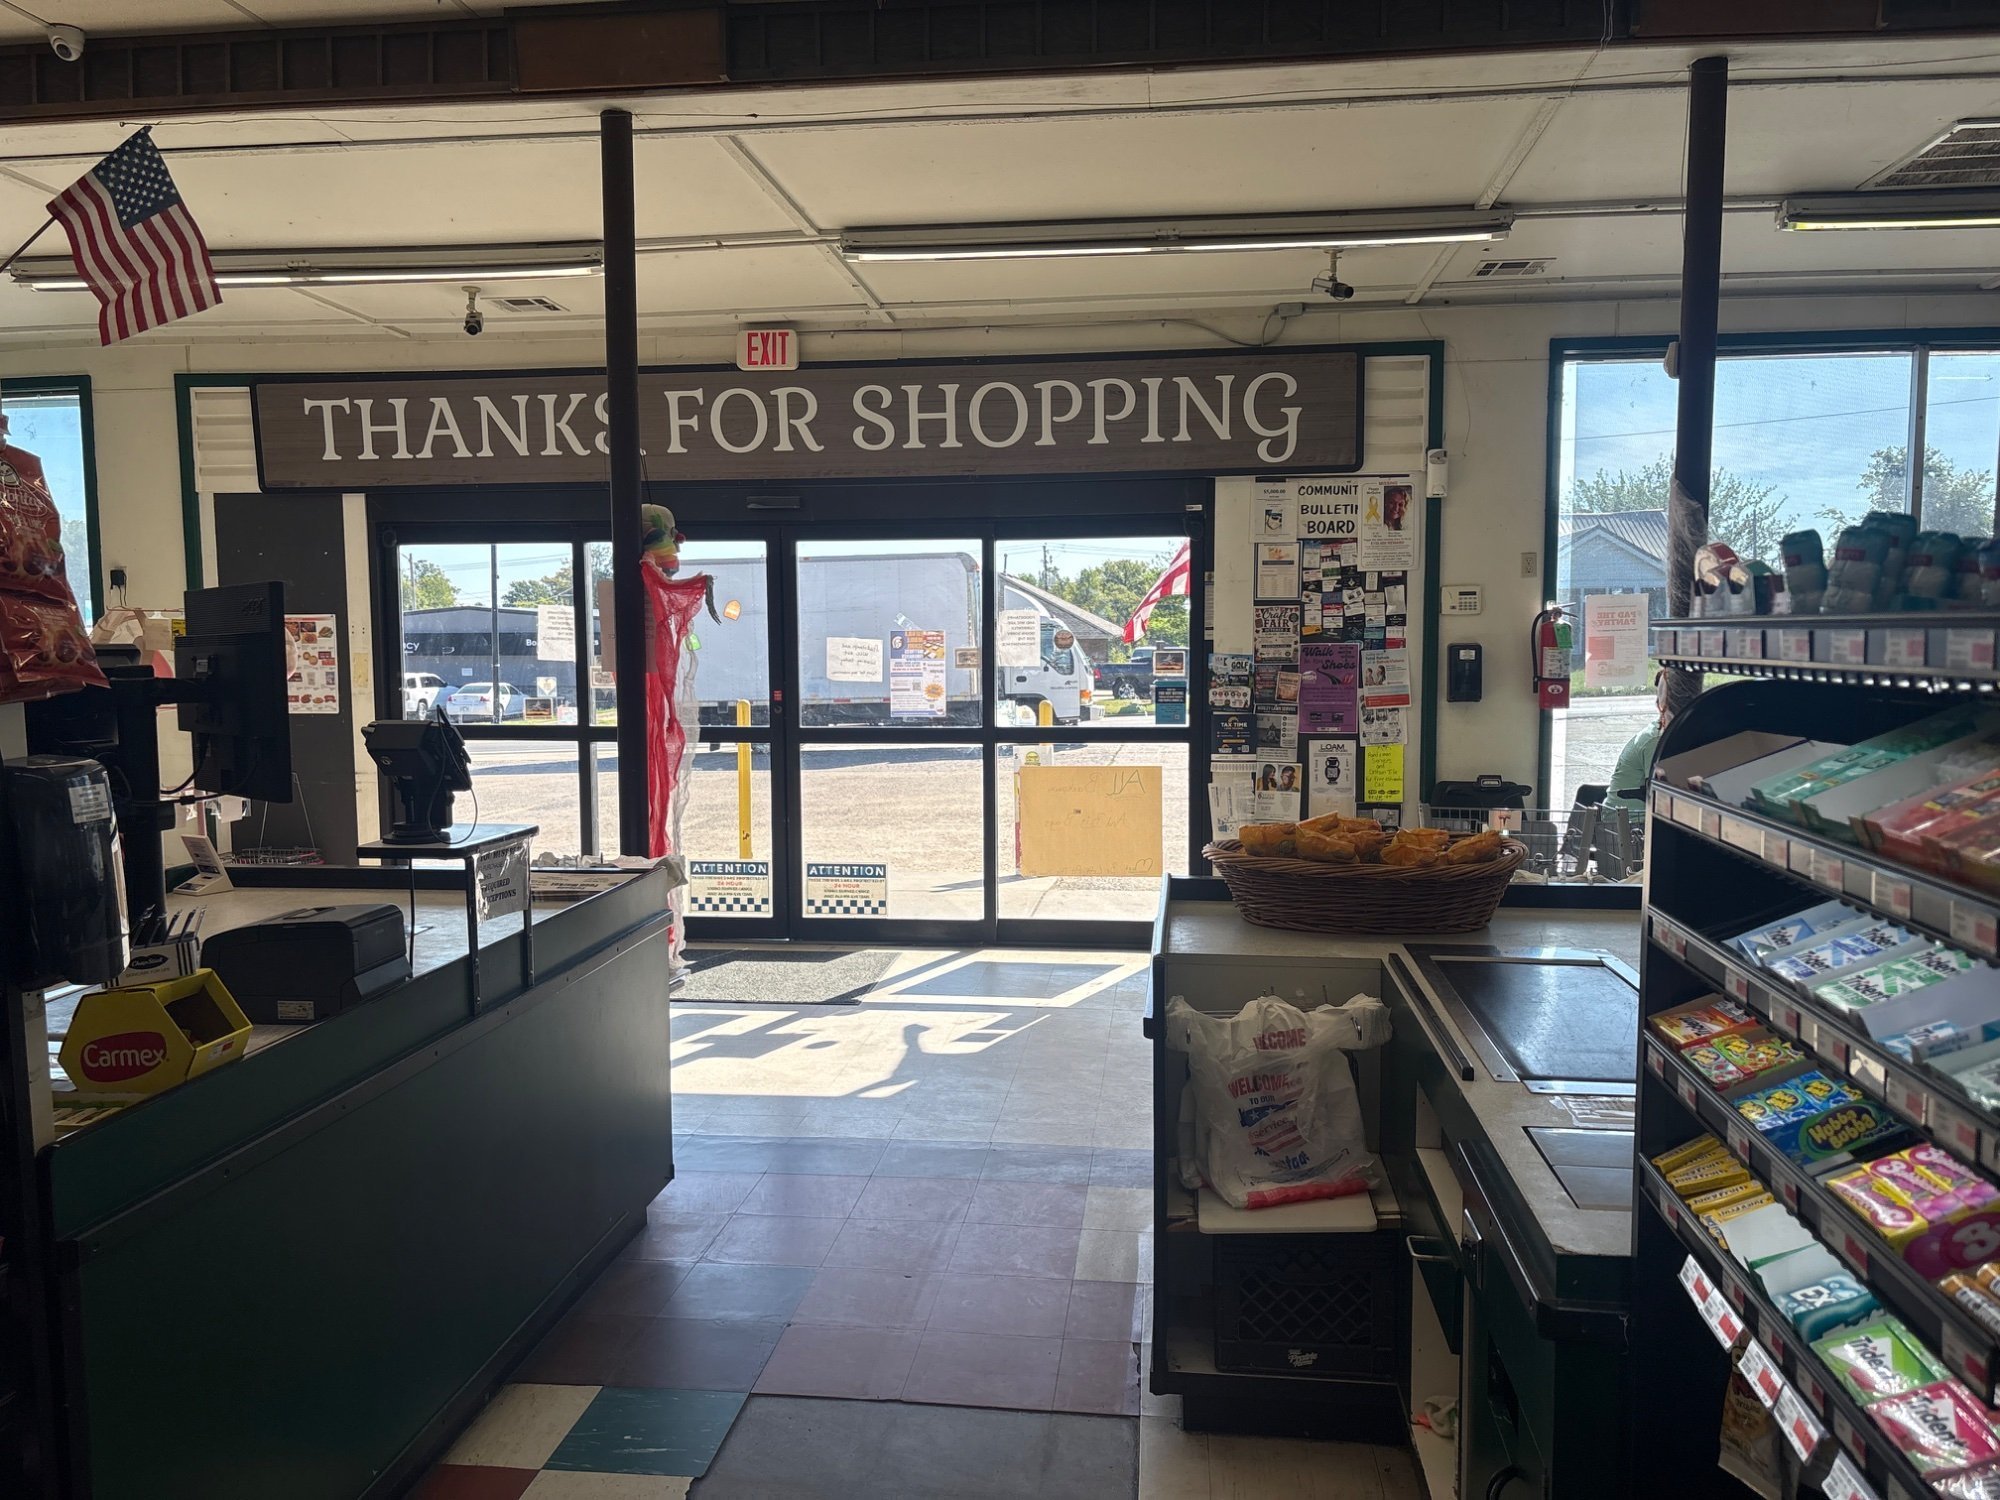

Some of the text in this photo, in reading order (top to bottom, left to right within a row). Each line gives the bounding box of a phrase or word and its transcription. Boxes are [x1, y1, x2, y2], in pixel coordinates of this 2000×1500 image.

[747, 332, 789, 366] EXIT
[664, 387, 825, 453] FOR
[852, 371, 1303, 463] SHOPPING
[1298, 485, 1358, 496] COMMUNIT
[1307, 520, 1355, 534] BOARD
[1263, 619, 1290, 628] FAIR
[1302, 646, 1334, 657] Walk
[1231, 661, 1249, 670] GOLF
[1322, 659, 1356, 670] Shoes
[1320, 743, 1345, 751] LOAM
[692, 863, 768, 875] ATTENTION
[808, 865, 885, 877] ATTENTION
[1840, 974, 1892, 1001] Trident
[83, 1044, 167, 1070] Carmex
[1227, 1073, 1290, 1099] WELCOME
[1249, 1094, 1276, 1105] TO OUR
[1808, 1109, 1857, 1144] Hubba
[1829, 1114, 1877, 1150] Bubba
[1849, 1335, 1901, 1381] Tridet
[1906, 1395, 1967, 1449] Trident
